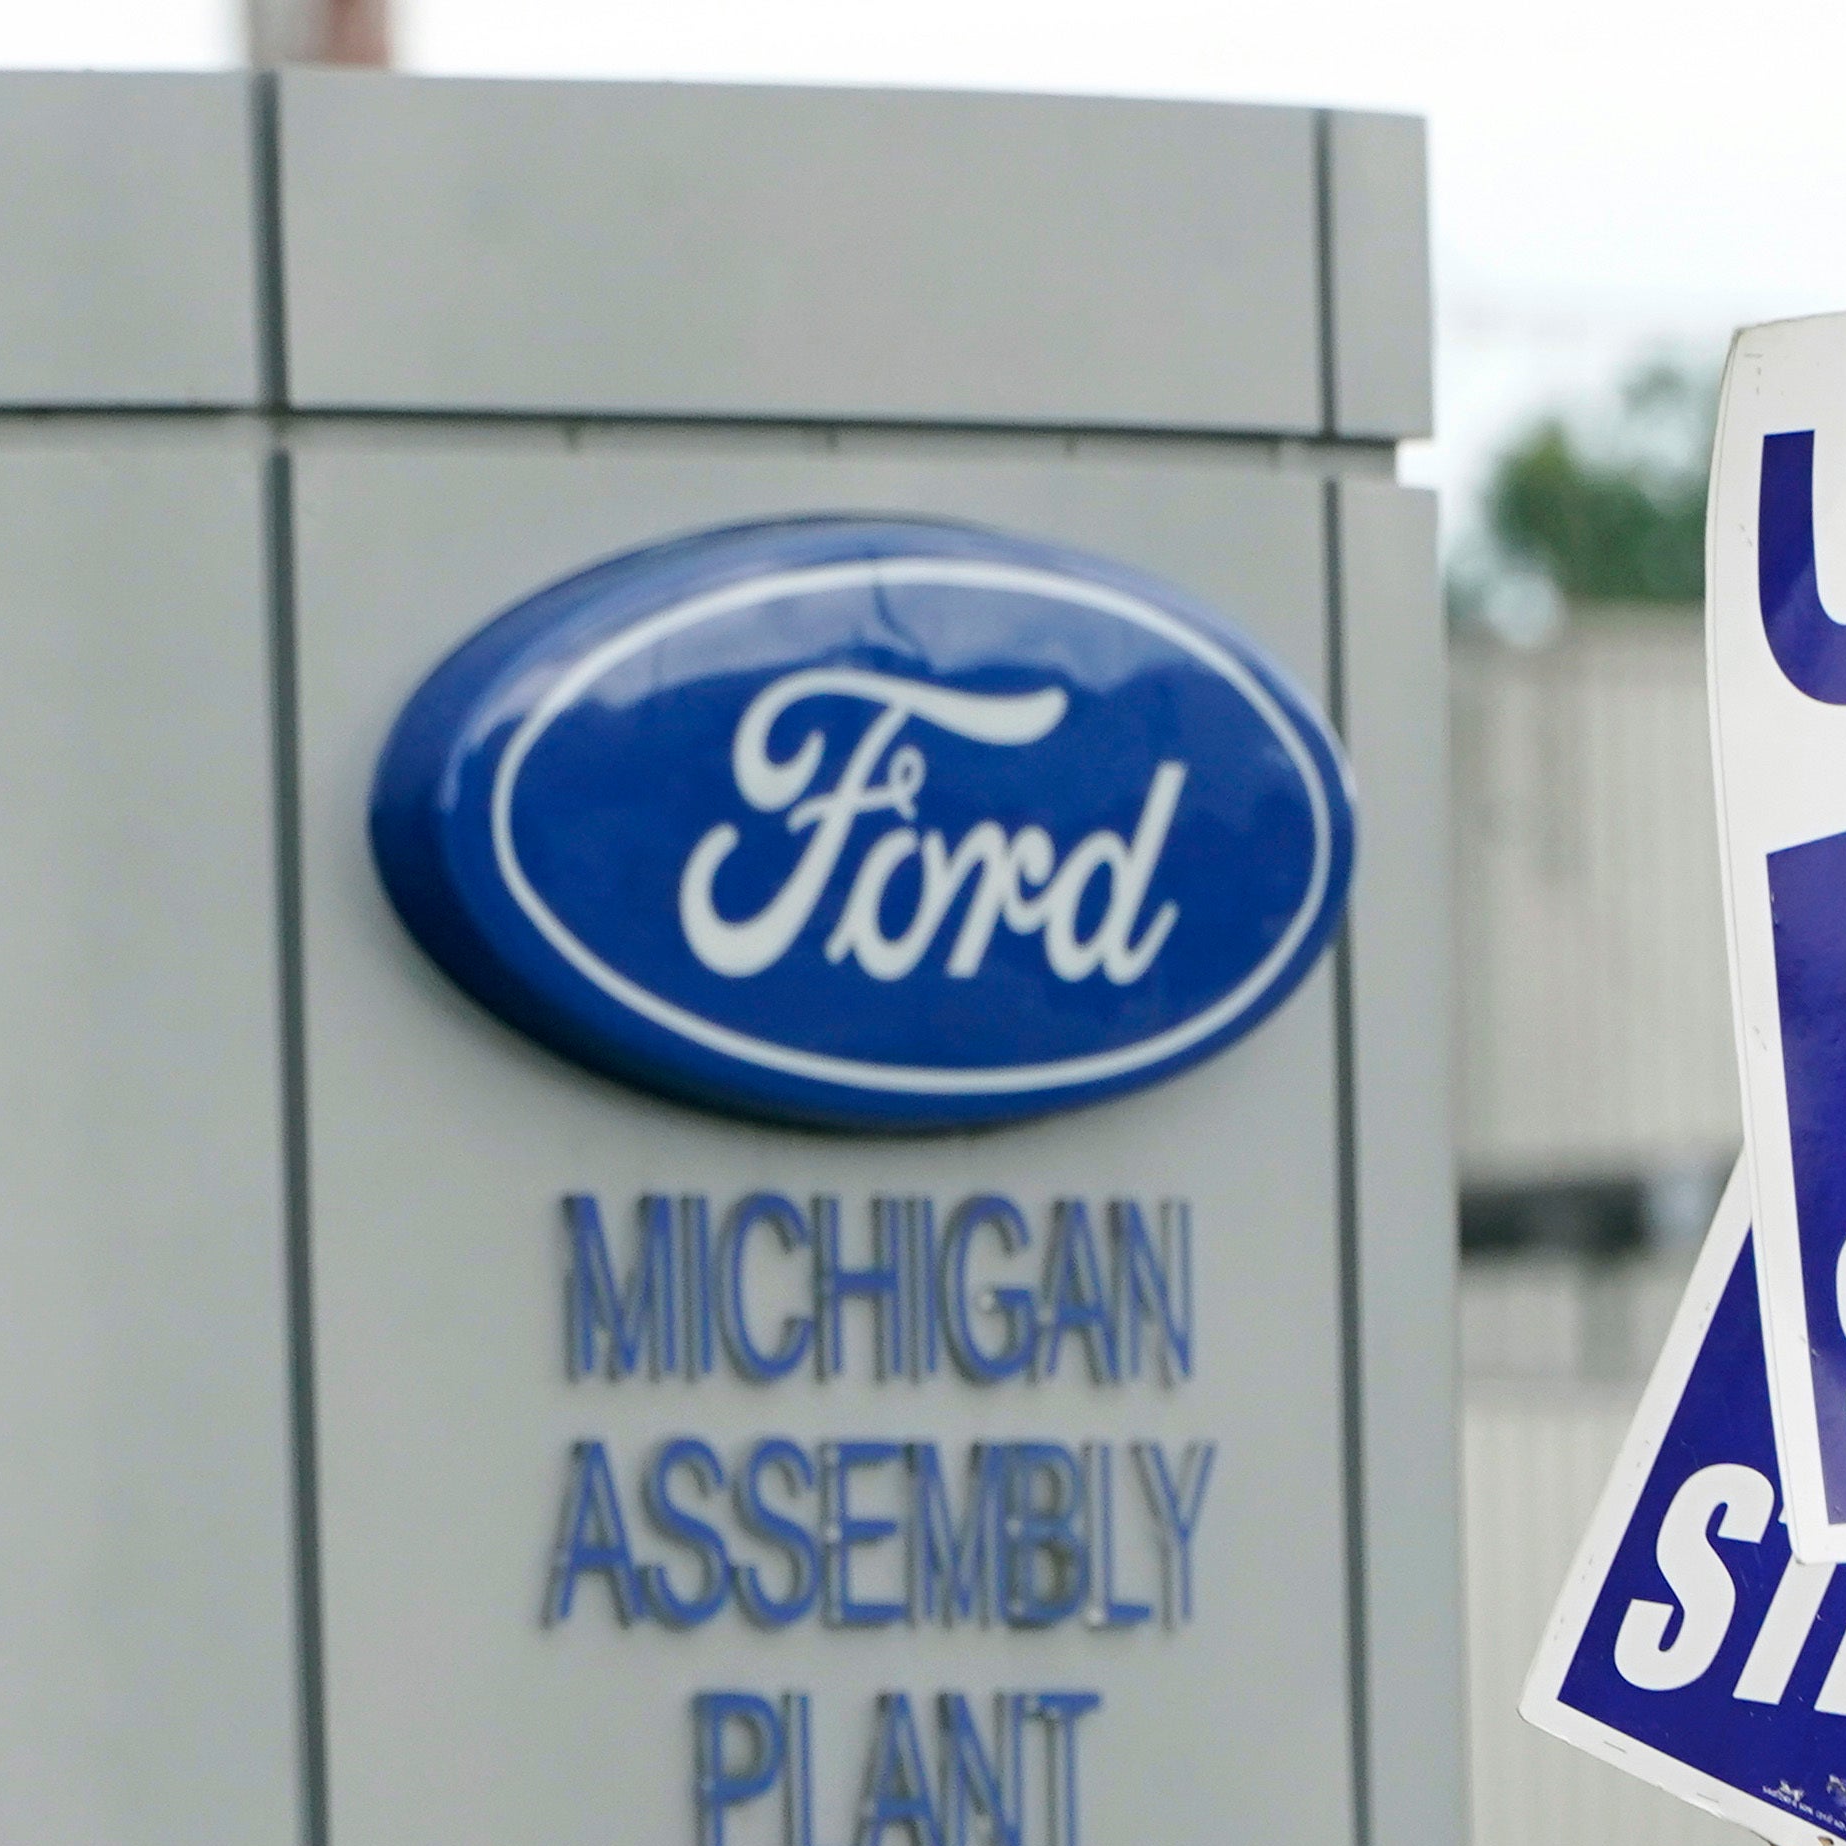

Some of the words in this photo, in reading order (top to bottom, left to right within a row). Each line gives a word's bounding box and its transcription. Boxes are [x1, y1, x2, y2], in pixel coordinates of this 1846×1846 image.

[677, 659, 1190, 988] Ford
[562, 1191, 1194, 1381] MICHIGAN
[544, 1437, 1216, 1626] ASSEMBLY
